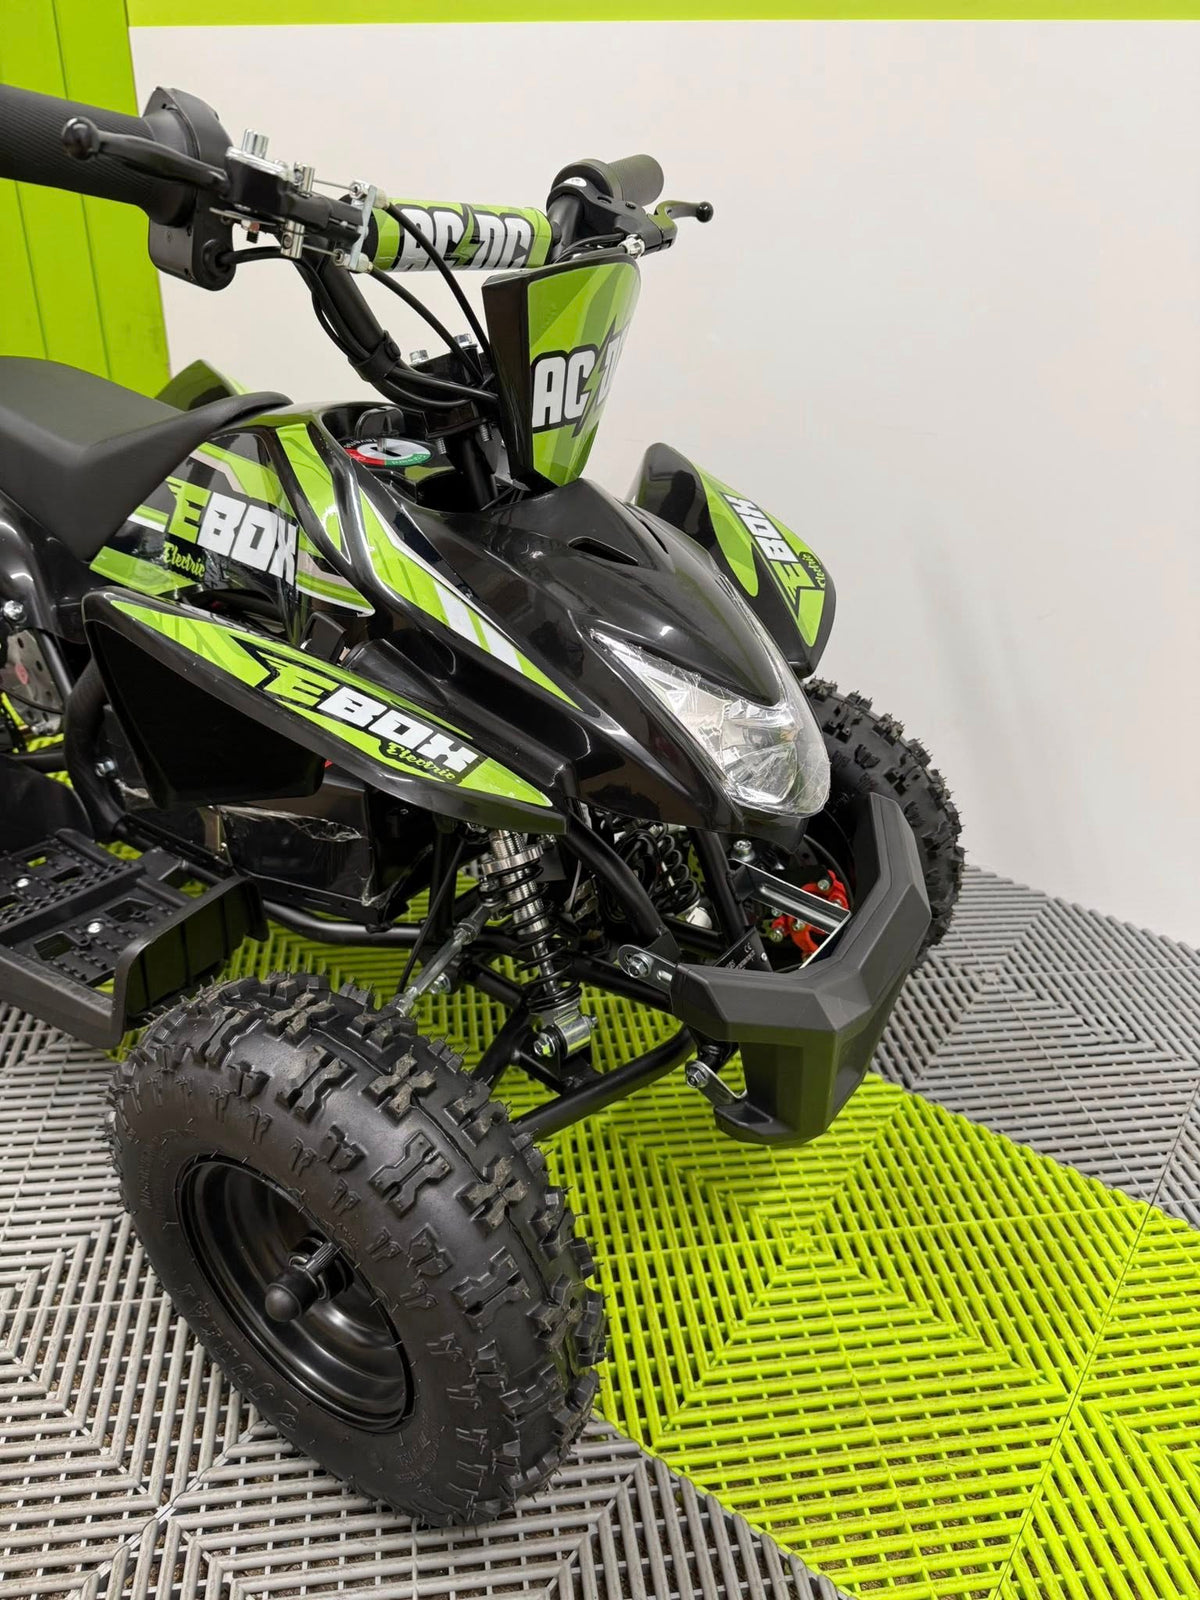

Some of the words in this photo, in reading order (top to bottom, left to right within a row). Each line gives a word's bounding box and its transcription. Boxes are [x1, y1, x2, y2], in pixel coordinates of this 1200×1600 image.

[163, 541, 206, 578] Electric
[164, 475, 299, 587] EBOX
[722, 493, 816, 605] EBOX
[256, 650, 479, 773] EBOX
[386, 742, 456, 781] Electric
